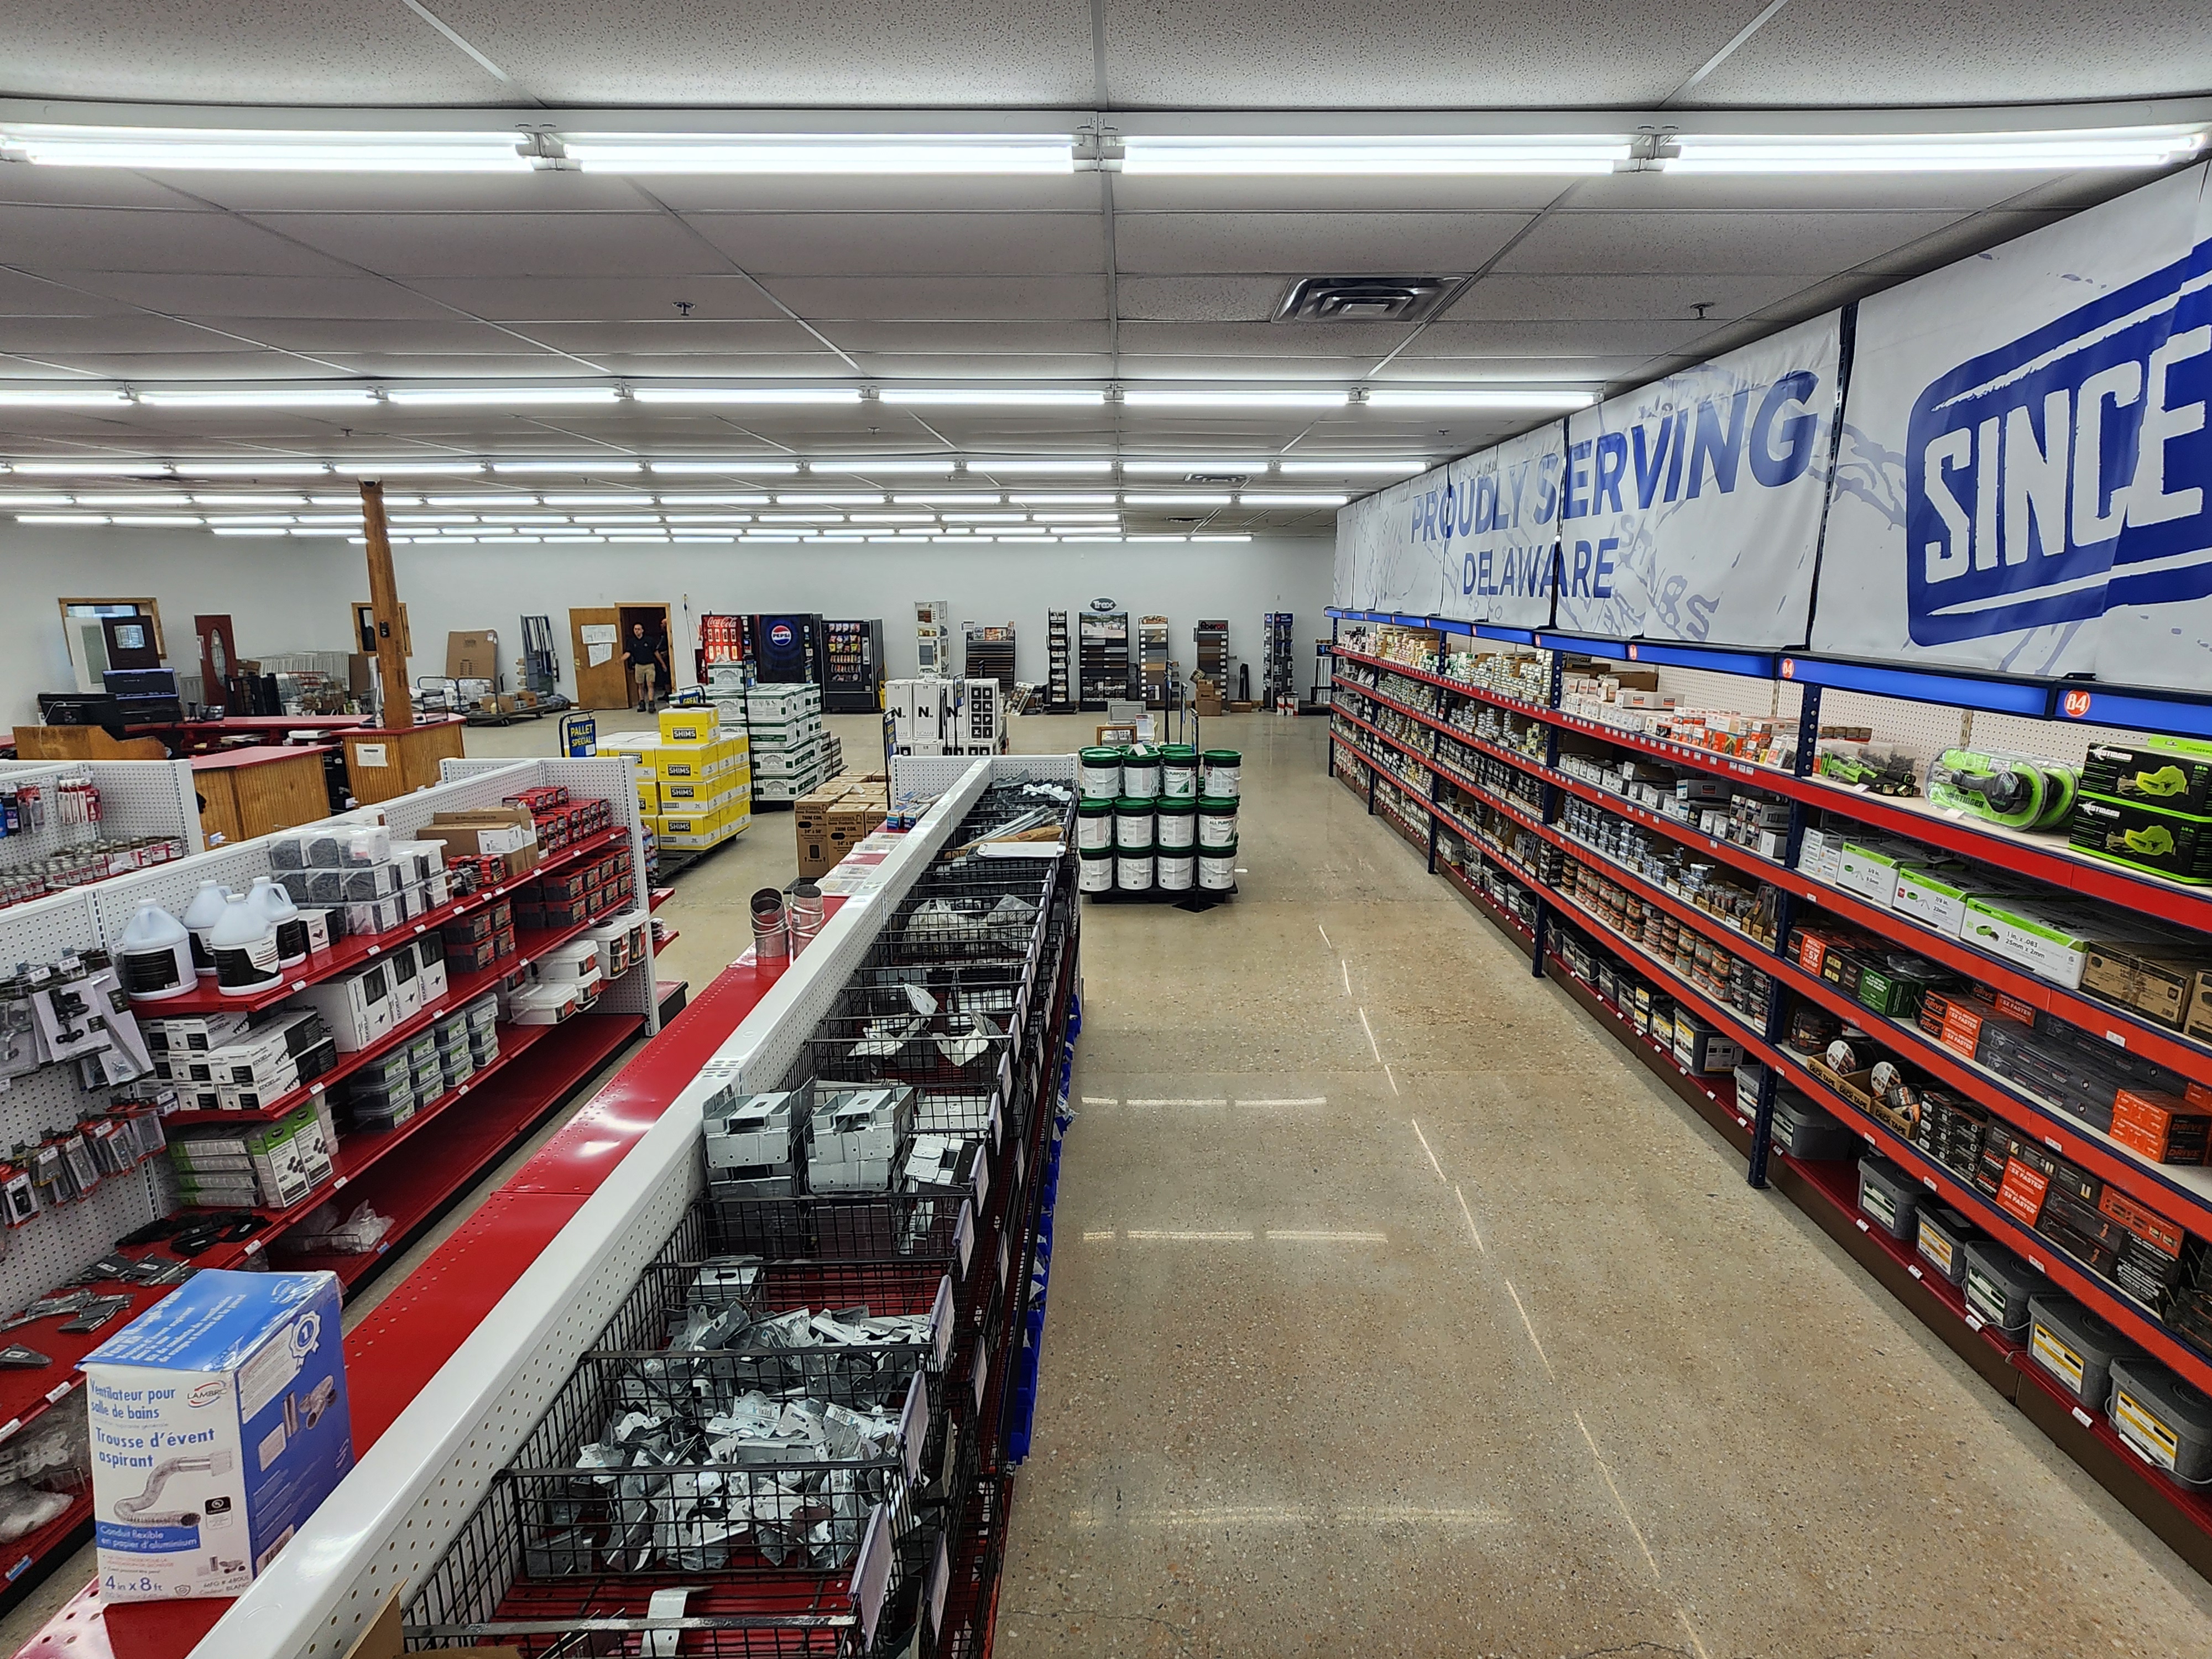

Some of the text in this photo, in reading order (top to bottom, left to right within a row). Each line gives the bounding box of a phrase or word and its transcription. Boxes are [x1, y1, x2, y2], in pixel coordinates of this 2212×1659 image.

[1411, 370, 1819, 544] PROUDLY SERVING
[1924, 325, 2212, 584] SINCE
[1463, 538, 1619, 599] DELAWARE
[1782, 663, 1793, 675] 84
[2067, 693, 2086, 712] 84
[919, 706, 929, 718] N
[570, 724, 593, 737] PALLET
[571, 736, 593, 747] SPECIAL!
[1954, 795, 1984, 808] STINGER
[1933, 906, 1947, 916] 22mm
[2011, 932, 2019, 940] in.
[2025, 939, 2038, 948] .083
[1808, 950, 1819, 963] 5X
[2006, 938, 2022, 951] 25mm
[2029, 948, 2045, 959] 2mm
[1802, 956, 1818, 969] FASTER
[1925, 998, 1945, 1012] DRIVE
[2011, 1003, 2031, 1016] FASTER
[1921, 1019, 1940, 1032] DRIVE
[1958, 1015, 1976, 1029] FASTER
[1954, 1036, 1973, 1050] FASTER
[1809, 1063, 1835, 1087] DECK TAPE
[1839, 1084, 1867, 1109] DECK TAPE
[1876, 1109, 1906, 1134] DECK TAPE
[1985, 1150, 2004, 1164] DRIVE
[1978, 1173, 1996, 1187] DRIVE
[2010, 1161, 2044, 1185] INSTALL DECKING
[2019, 1171, 2043, 1190] FASTER
[2003, 1184, 2037, 1209] INSTALL DECKING
[2012, 1195, 2036, 1214] FASTER
[90, 1379, 176, 1404] Ventilateur pour
[91, 1400, 159, 1420] salle de bains
[96, 1427, 215, 1448] Trousse d'évent
[99, 1451, 154, 1469] aspirant
[100, 1526, 163, 1540] Conduit flexible
[113, 1538, 138, 1549] papier
[140, 1537, 197, 1549] d'aluminium
[105, 1575, 116, 1590] 4
[140, 1577, 152, 1592] 8
[154, 1583, 163, 1592] ft
